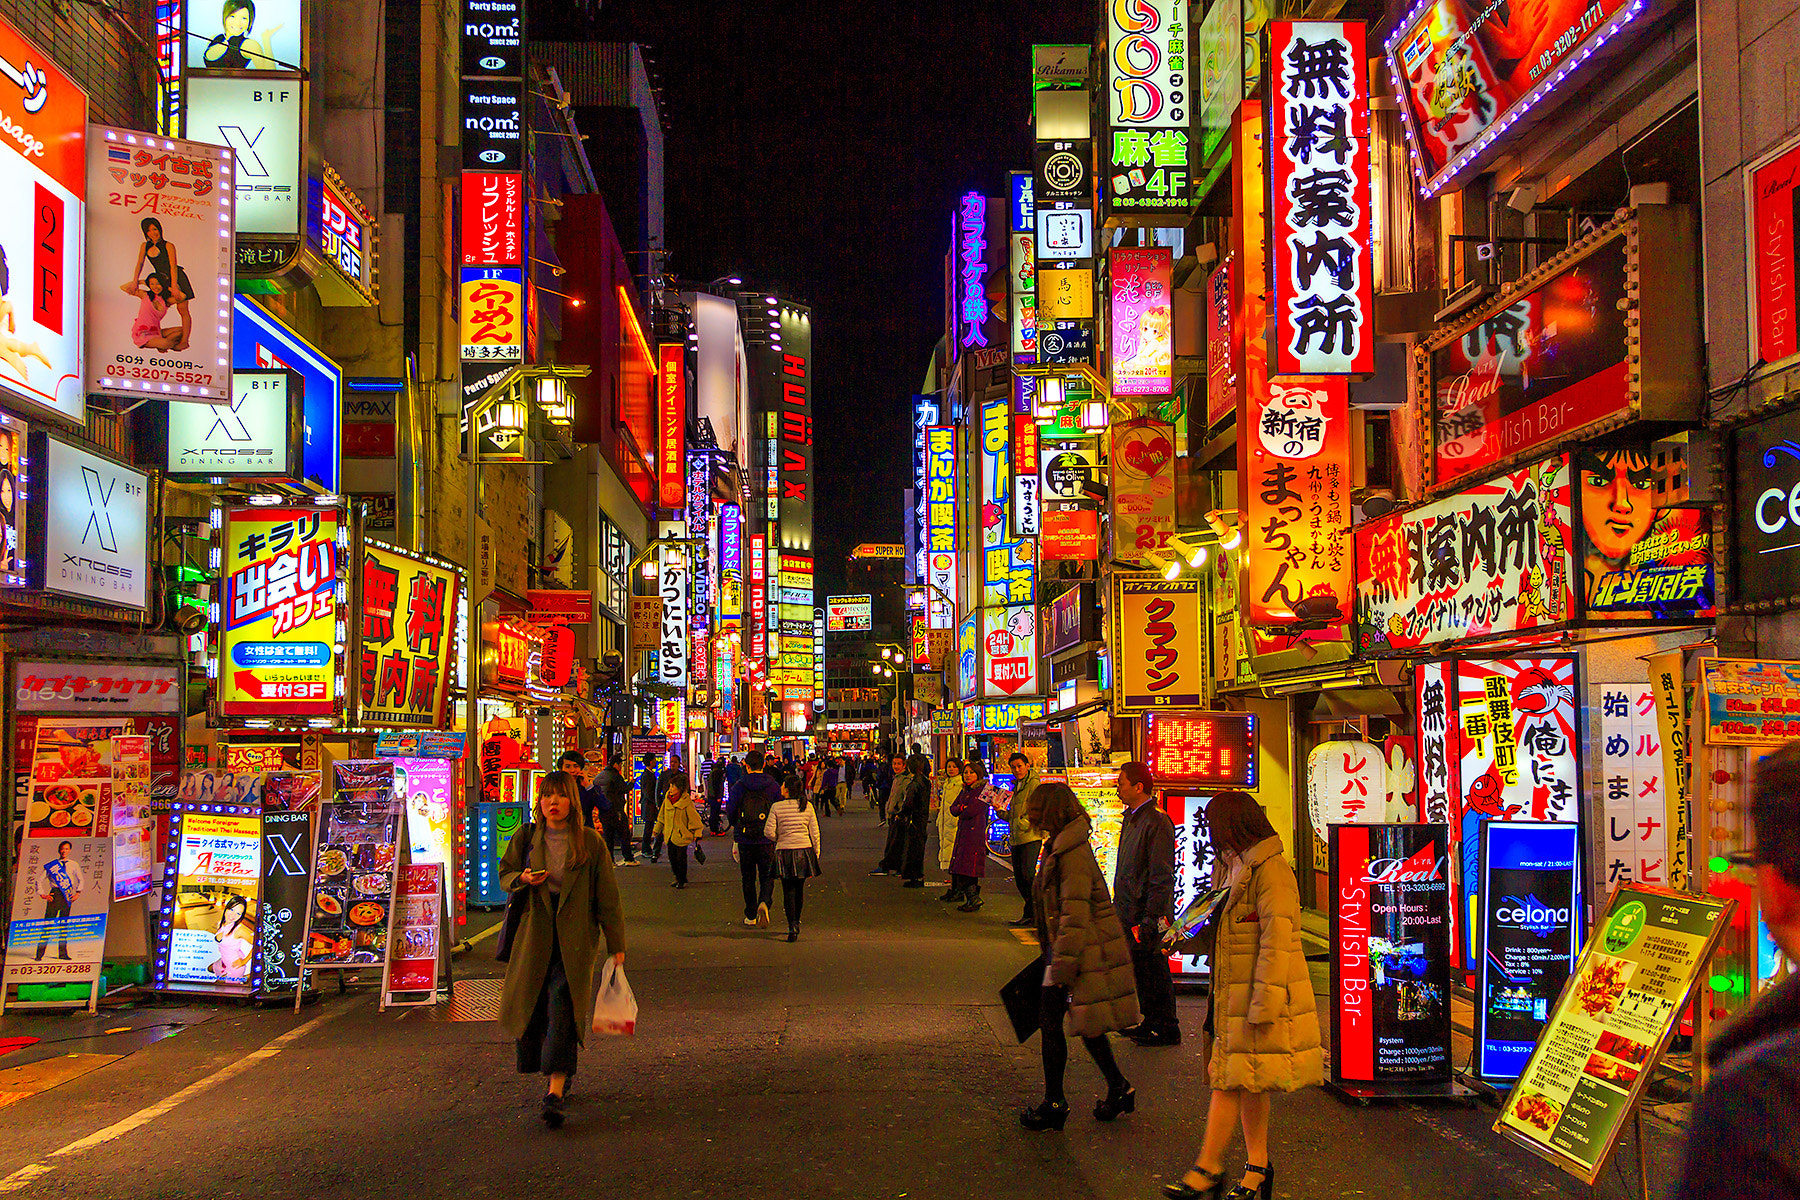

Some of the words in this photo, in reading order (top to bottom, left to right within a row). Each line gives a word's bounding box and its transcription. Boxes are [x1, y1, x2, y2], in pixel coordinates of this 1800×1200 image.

[469, 2, 490, 11] Party
[492, 2, 516, 11] Space
[1529, 67, 1542, 81] TEL
[1540, 2, 1605, 71] 03-3202-1771
[486, 59, 499, 67] 4F
[253, 91, 290, 103] B1F
[469, 95, 490, 104] Party
[492, 95, 516, 104] Space
[486, 153, 499, 161] 3F
[1111, 128, 1188, 168] 麻雀
[133, 150, 213, 179] タイ古式
[107, 166, 214, 197] マッサージ
[1146, 169, 1187, 197] 4F
[108, 192, 138, 208] 2F
[506, 177, 516, 228] レンタルルーム
[1055, 202, 1073, 210] 5F
[1288, 36, 1358, 359] 無料案内所
[482, 177, 499, 263] リフレッシュ
[506, 231, 516, 260] ホステル
[1114, 252, 1167, 261] リラクゼーション
[483, 270, 503, 279] 1F
[962, 192, 988, 348] カラオケの鉄人
[1125, 264, 1156, 273] リゾート
[1057, 278, 1072, 305] 馬心
[1145, 290, 1162, 298] 6F
[469, 282, 514, 344] らーめん
[116, 353, 145, 366] 60分
[464, 346, 519, 359] 博多天神
[106, 364, 213, 386] 03-3207-5527
[464, 374, 487, 395] Party
[1444, 350, 1507, 418] Real
[252, 381, 281, 390] B1F
[665, 361, 678, 474] 個室ダイニング居酒屋
[1262, 408, 1323, 442] 新宿
[496, 434, 511, 442] B1
[1060, 442, 1077, 450] 1F
[1284, 440, 1304, 456] の
[1053, 473, 1065, 481] The
[1066, 473, 1085, 481] Olive
[125, 482, 142, 498] B1F
[930, 430, 954, 551] まんが喫茶
[1325, 463, 1342, 525] 博多もつ鍋
[692, 470, 706, 533] ホテルがライバル
[1307, 465, 1326, 570] 九州のうまかもん
[239, 511, 321, 562] キラリ
[724, 505, 739, 559] カラオケ
[1261, 463, 1306, 609] まっちゃん
[876, 546, 894, 556] SUPER
[1327, 528, 1344, 572] 水炊き
[61, 568, 106, 588] DINING
[113, 580, 133, 593] BAR
[234, 542, 330, 620] 出会い
[1124, 582, 1196, 591] オンラインカフェ
[1594, 565, 1708, 608] 北斗割引券
[273, 589, 332, 638] カフェ
[363, 553, 448, 656] 無料
[661, 529, 684, 680] とかつにいむら
[1405, 586, 1518, 638] ファイナルアンサー
[989, 633, 1010, 645] 24H
[1145, 597, 1180, 692] クラウン
[990, 646, 1009, 654] 営業
[784, 674, 802, 682] ゲーム
[993, 662, 1027, 681] 受付入口
[261, 683, 325, 698] 受付3F
[1155, 697, 1171, 705] B1
[1726, 699, 1758, 712] 50min
[1157, 721, 1212, 747] 地域
[1463, 698, 1484, 757] 一番!
[1486, 676, 1518, 786] 歌舞伎町で
[1721, 720, 1758, 735] 100min
[1523, 720, 1573, 821] 俺にき
[1602, 691, 1632, 883] 始めました
[291, 813, 308, 823] BAR
[187, 825, 219, 833] Traditional
[201, 838, 260, 850] タイ古式マッサージ
[1361, 856, 1445, 883] Real
[1401, 883, 1446, 892] 03-3203-6692
[1372, 904, 1397, 914] Open
[1400, 903, 1424, 913] Hours
[1495, 905, 1569, 924] celona
[1706, 910, 1720, 922] 6F
[1402, 914, 1442, 926] 20:00-Last
[1520, 923, 1538, 931] Stylish
[21, 964, 91, 976] 03-3207-8288
